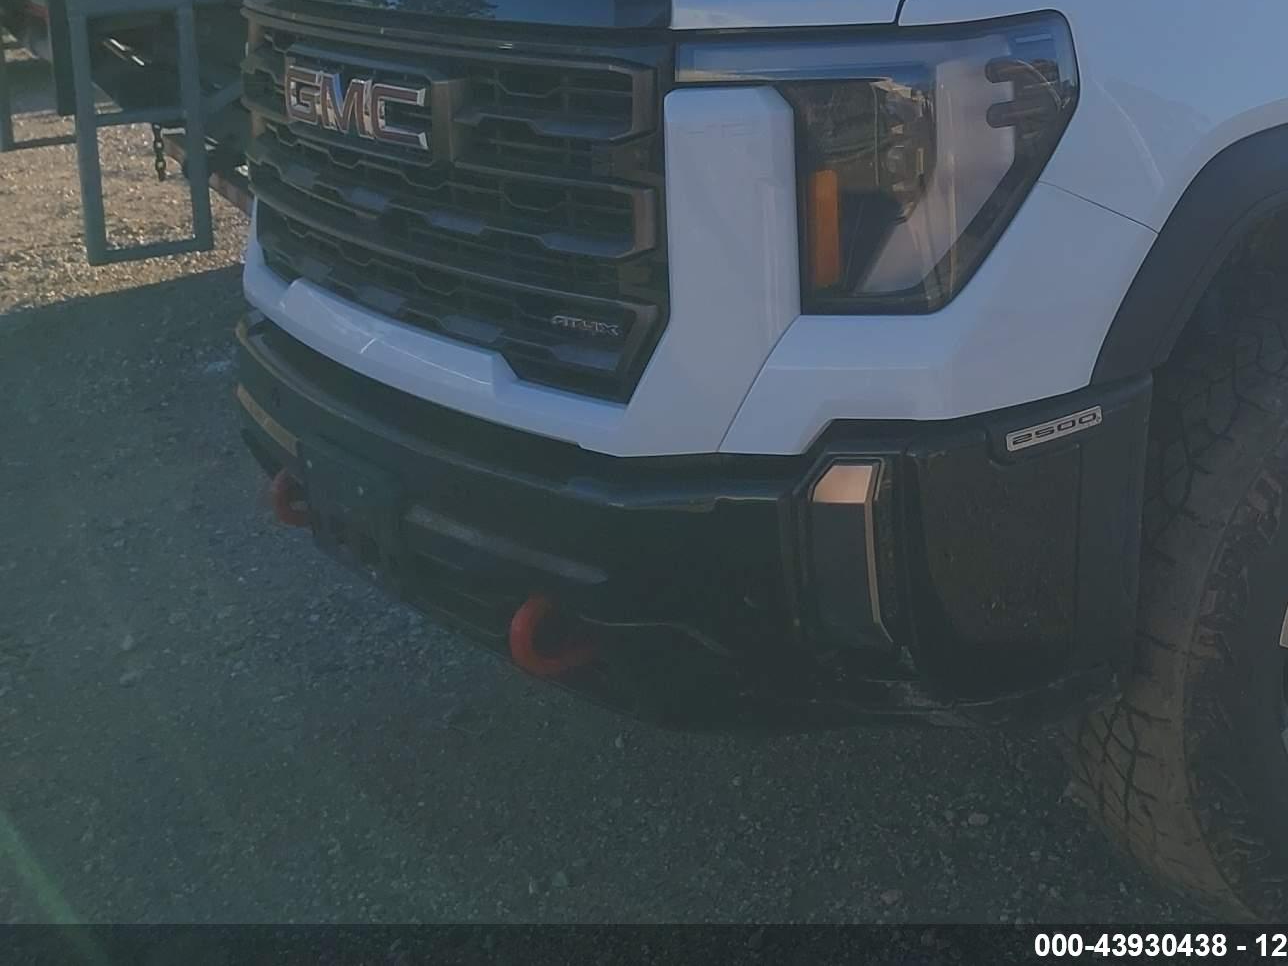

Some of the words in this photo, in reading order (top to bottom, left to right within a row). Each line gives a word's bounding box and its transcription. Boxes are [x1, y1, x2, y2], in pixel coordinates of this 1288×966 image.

[285, 65, 429, 150] GMC
[551, 315, 619, 336] AT4X
[1012, 412, 1097, 446] 2500
